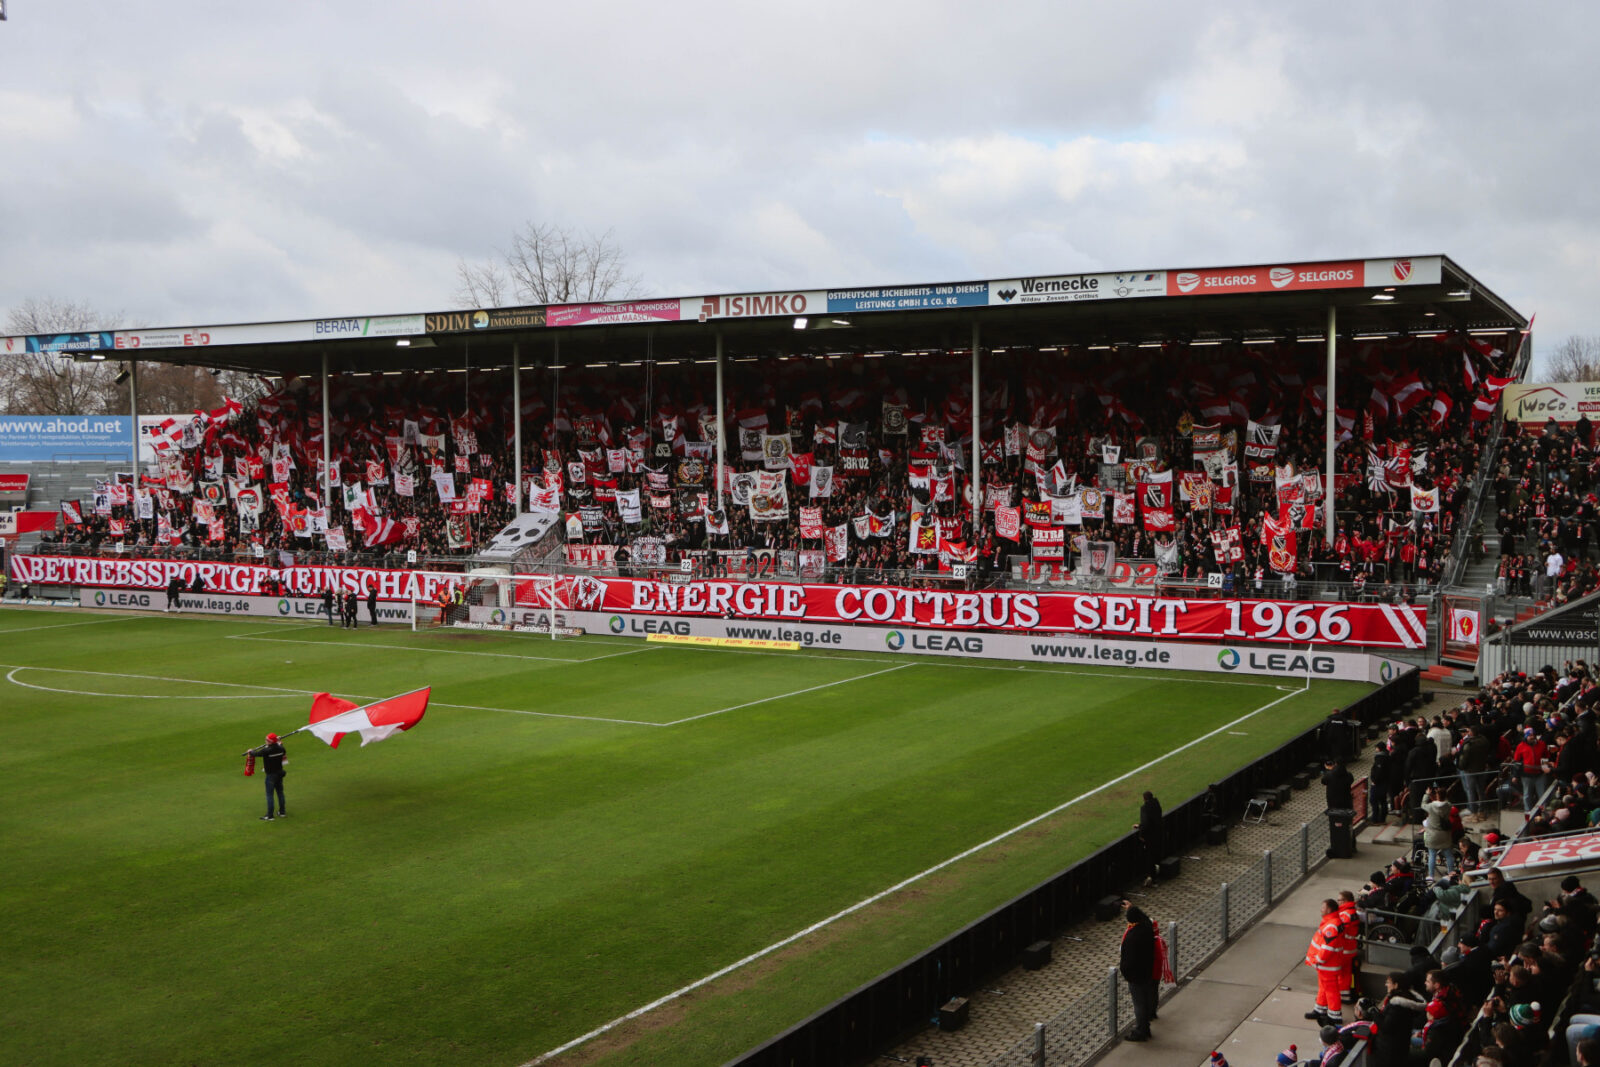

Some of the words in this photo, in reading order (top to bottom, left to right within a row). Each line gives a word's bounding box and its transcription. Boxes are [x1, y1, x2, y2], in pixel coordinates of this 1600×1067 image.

[1020, 275, 1099, 293] Wernecke
[1204, 275, 1257, 287] SELGROS
[1299, 270, 1354, 283] SELGROS
[828, 289, 880, 300] OSTDEUTSCHE
[881, 287, 934, 298] SICHERHEITS-
[935, 286, 954, 295] UND
[955, 285, 988, 294] DIENST-
[590, 305, 627, 314] IMMOBILIEN
[636, 302, 679, 312] WOHNDESIGN
[725, 294, 807, 316] ISIMKO
[855, 300, 897, 310] LEISTUNGS
[898, 299, 921, 308] GMBH
[922, 298, 930, 307] &
[931, 298, 945, 306] CO.
[946, 297, 958, 305] KG
[316, 319, 360, 334] BERATA
[426, 313, 471, 333] SDIM
[490, 315, 546, 328] IMMOBILIEN
[68, 341, 89, 350] WASSER
[0, 418, 122, 433] www.ahod.net
[682, 561, 691, 570] 22
[955, 567, 965, 577] 23
[1209, 575, 1221, 585] 24
[109, 593, 150, 606] LEAG
[179, 597, 250, 612] www.leag.de
[631, 580, 807, 617] ENERGIE
[835, 587, 1041, 628] COTTBUS
[1073, 595, 1188, 635] SEIT
[1224, 601, 1352, 642] 1966
[631, 618, 691, 636] LEAG
[726, 626, 842, 646] www.leag.de
[1528, 630, 1598, 639] www.wasc
[912, 634, 983, 653] LEAG
[1031, 644, 1170, 665] www.leag.de
[1249, 652, 1335, 673] LEAG
